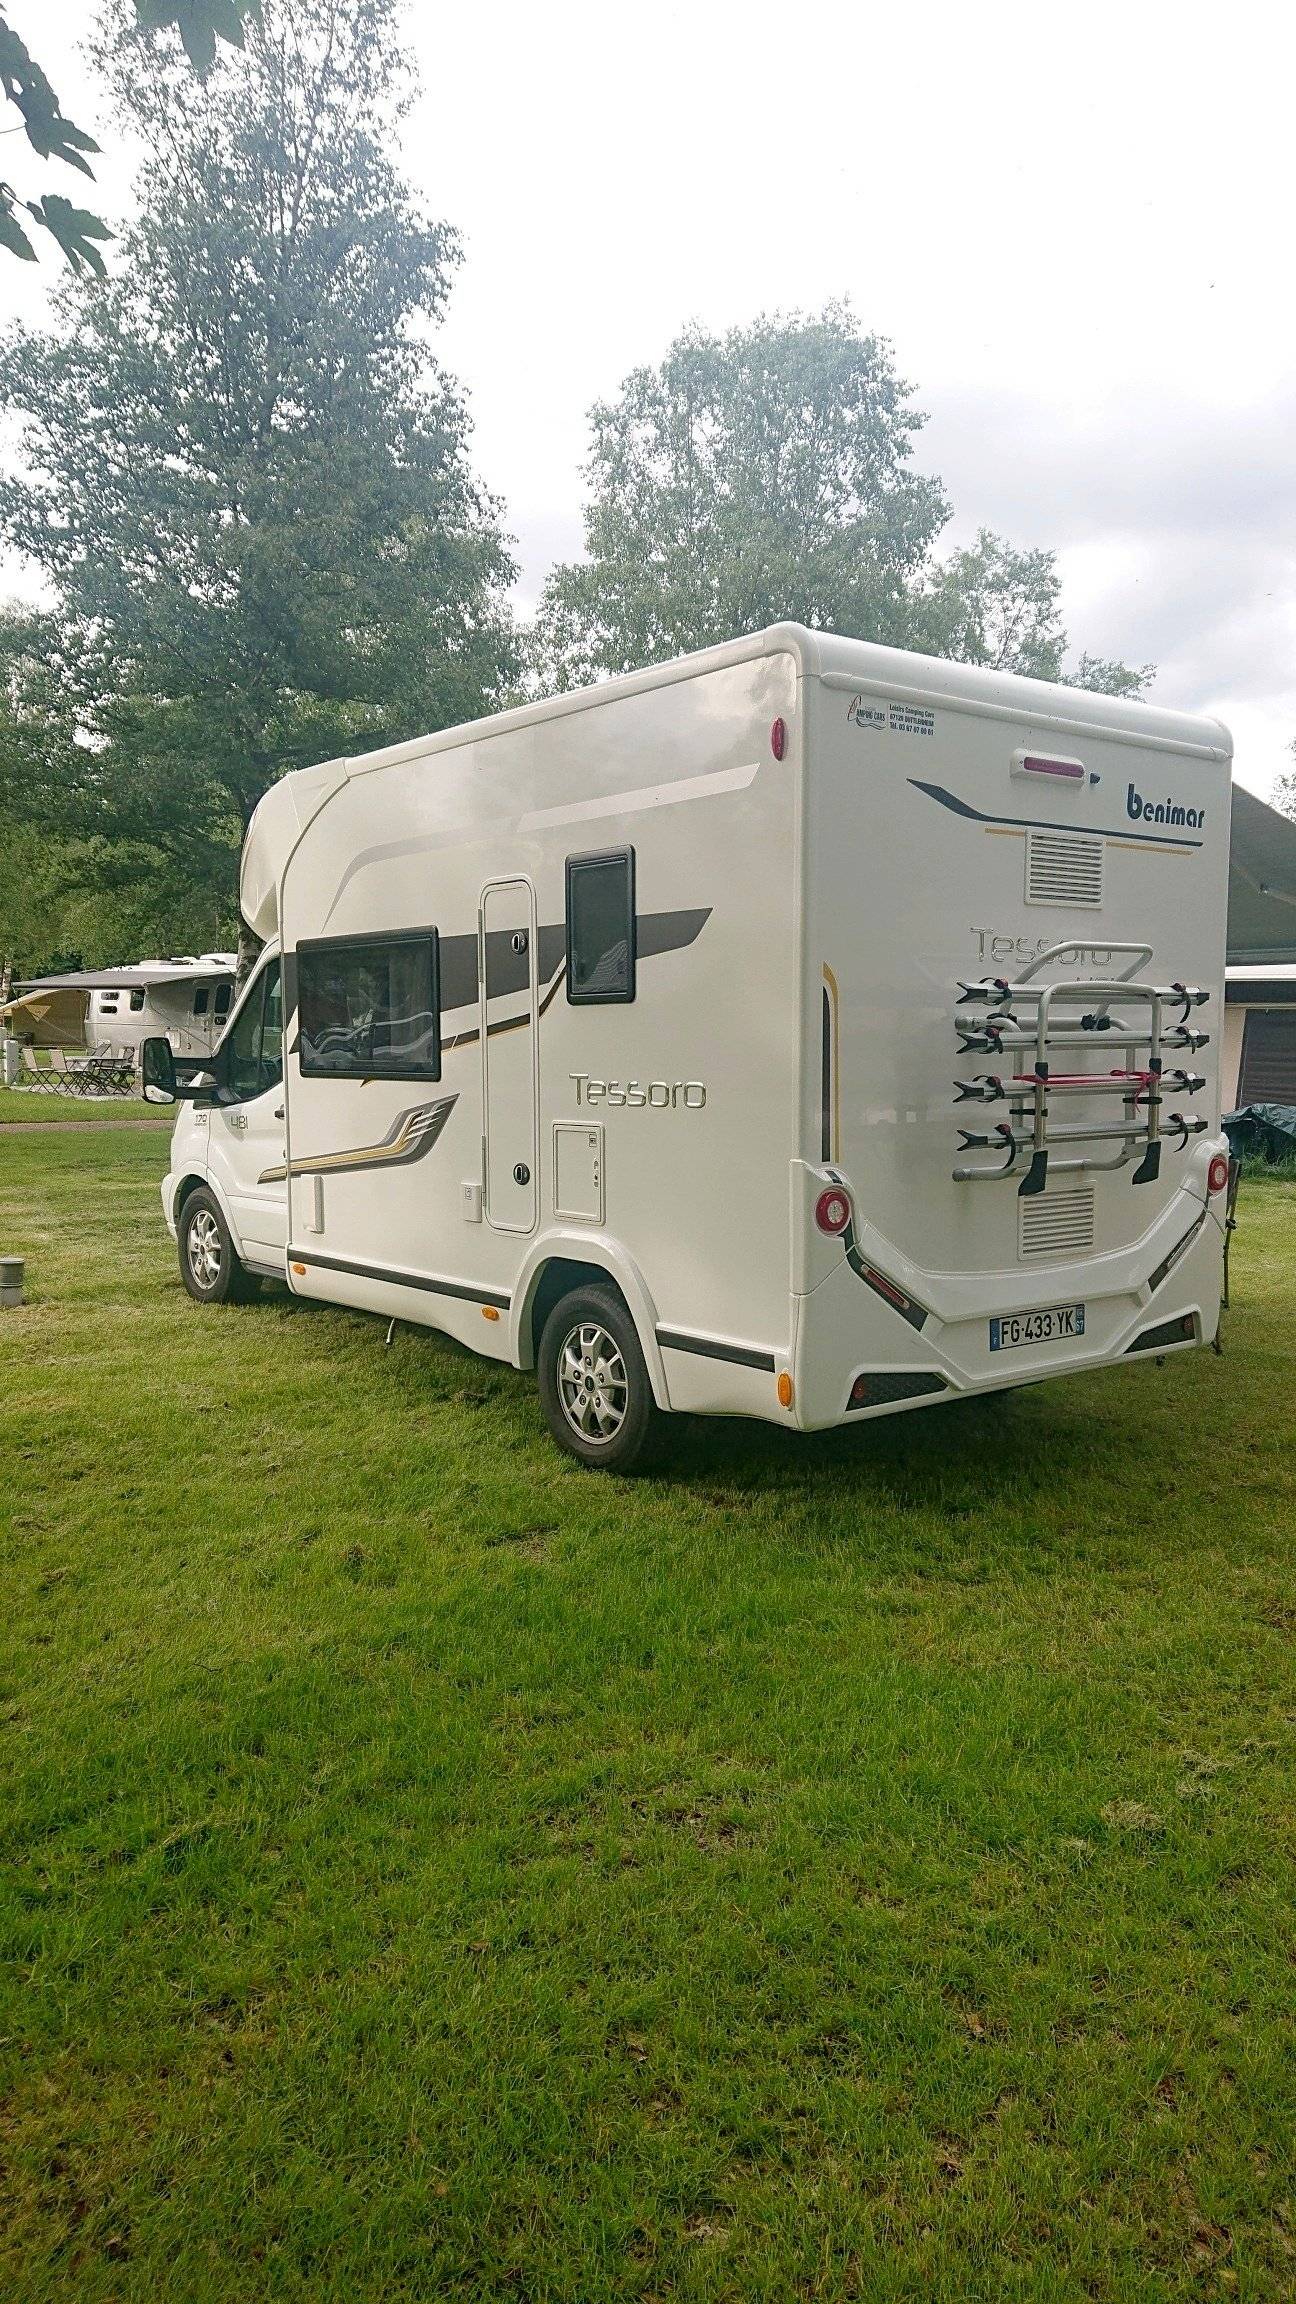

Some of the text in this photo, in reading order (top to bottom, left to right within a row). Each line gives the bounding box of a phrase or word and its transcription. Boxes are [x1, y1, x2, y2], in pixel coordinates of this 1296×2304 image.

[874, 712, 885, 721] CARS
[889, 704, 904, 713] Loisirs
[905, 707, 924, 717] Camping
[1127, 783, 1205, 828] benimar
[569, 1073, 707, 1109] Tessoro
